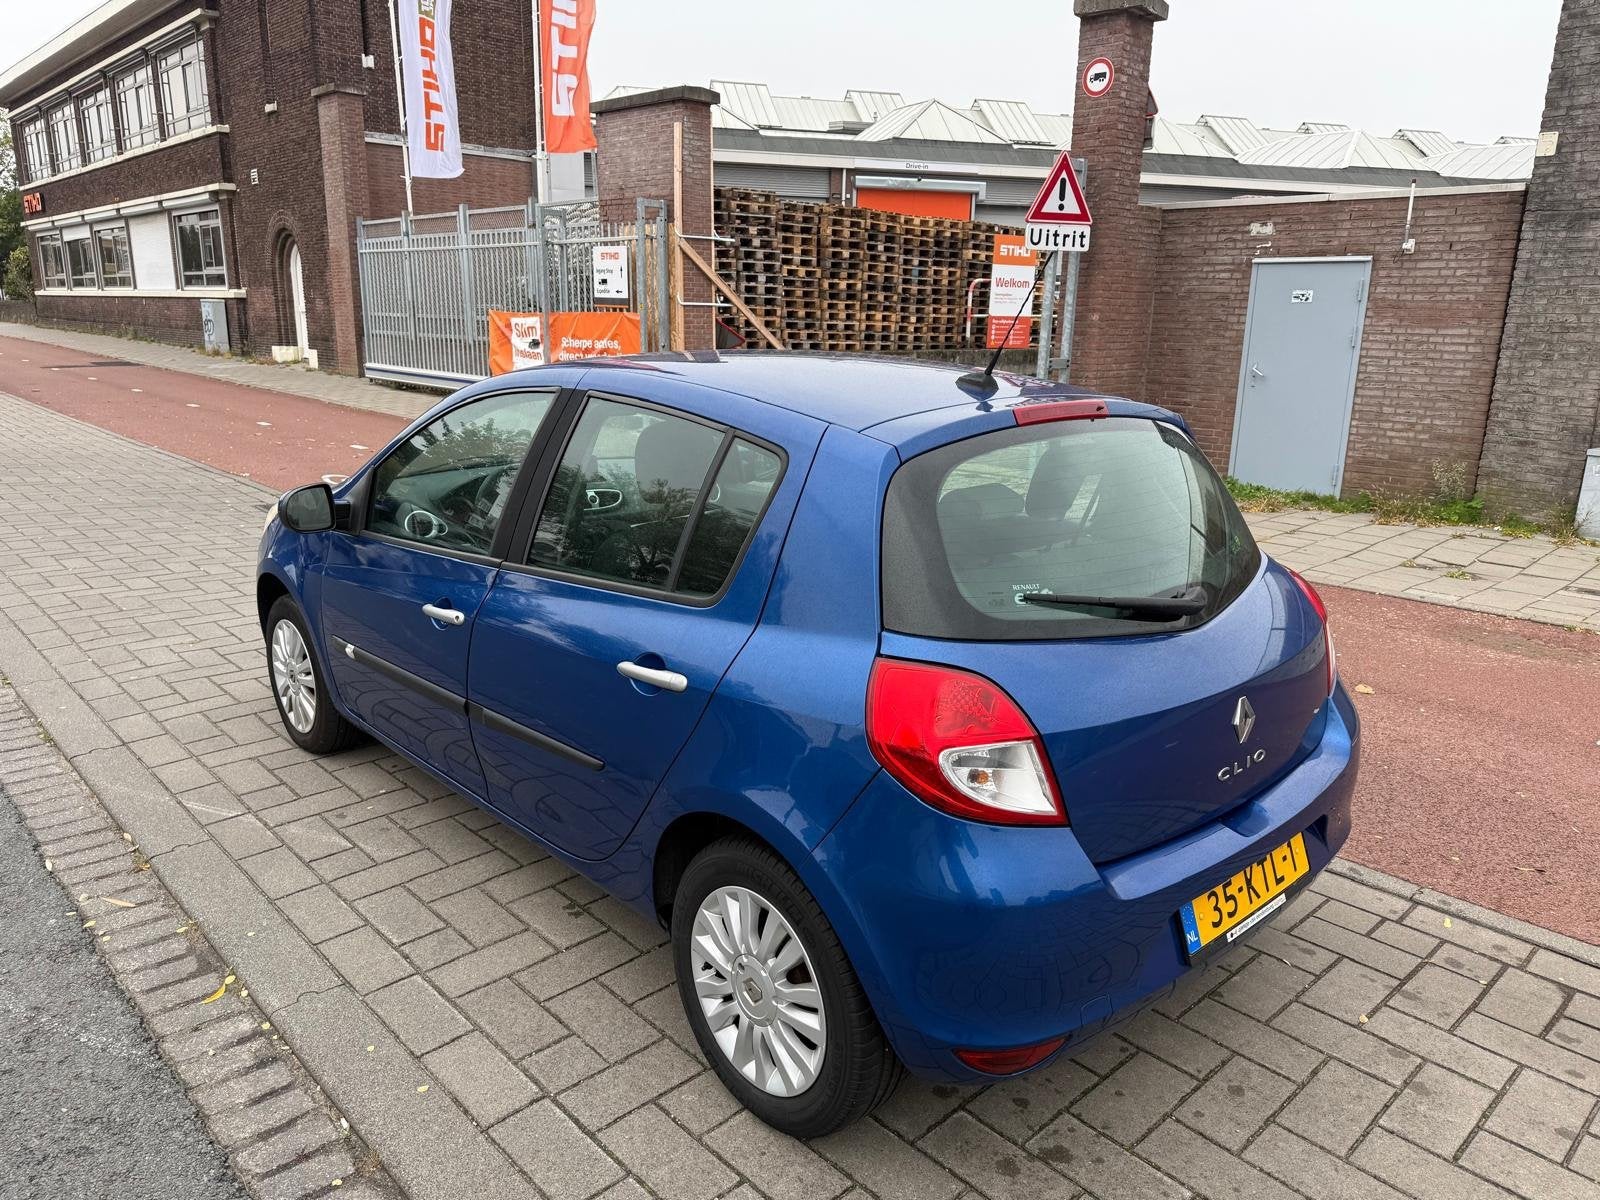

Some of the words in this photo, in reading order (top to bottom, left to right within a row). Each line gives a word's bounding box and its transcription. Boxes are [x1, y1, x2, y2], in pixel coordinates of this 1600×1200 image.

[418, 16, 445, 152] STIHO
[24, 193, 42, 214] STIHO
[1030, 228, 1086, 248] Uitrit
[601, 252, 620, 260] STIHO
[995, 277, 1030, 289] Welkom
[514, 322, 538, 338] Slim
[561, 336, 592, 350] Scherpe
[1218, 749, 1266, 781] CLIO
[1207, 841, 1297, 929] 35-KTL-1
[1186, 930, 1199, 945] NL
